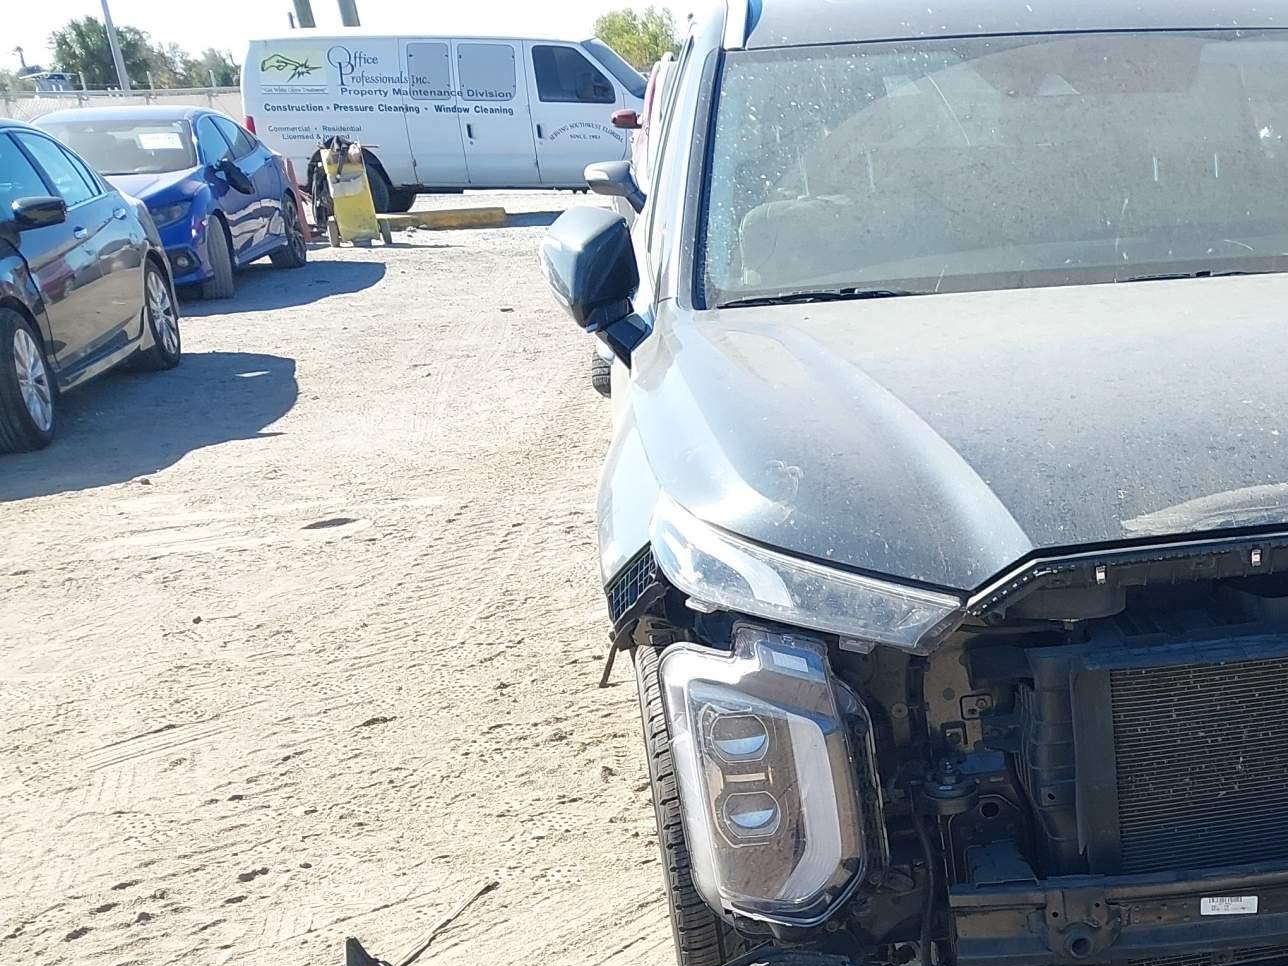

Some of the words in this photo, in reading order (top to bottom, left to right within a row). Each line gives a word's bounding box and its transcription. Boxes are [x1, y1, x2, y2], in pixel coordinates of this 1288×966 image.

[327, 45, 379, 68] Office
[337, 61, 408, 86] Professionals
[411, 74, 431, 86] Inc.
[340, 87, 389, 98] Property
[392, 87, 463, 97] Maintenance
[466, 89, 513, 98] Division
[264, 103, 324, 112] Construction
[333, 103, 374, 112] Pressure
[377, 103, 420, 114] Cleaning
[433, 104, 470, 113] Window
[473, 105, 514, 116] Cleaning
